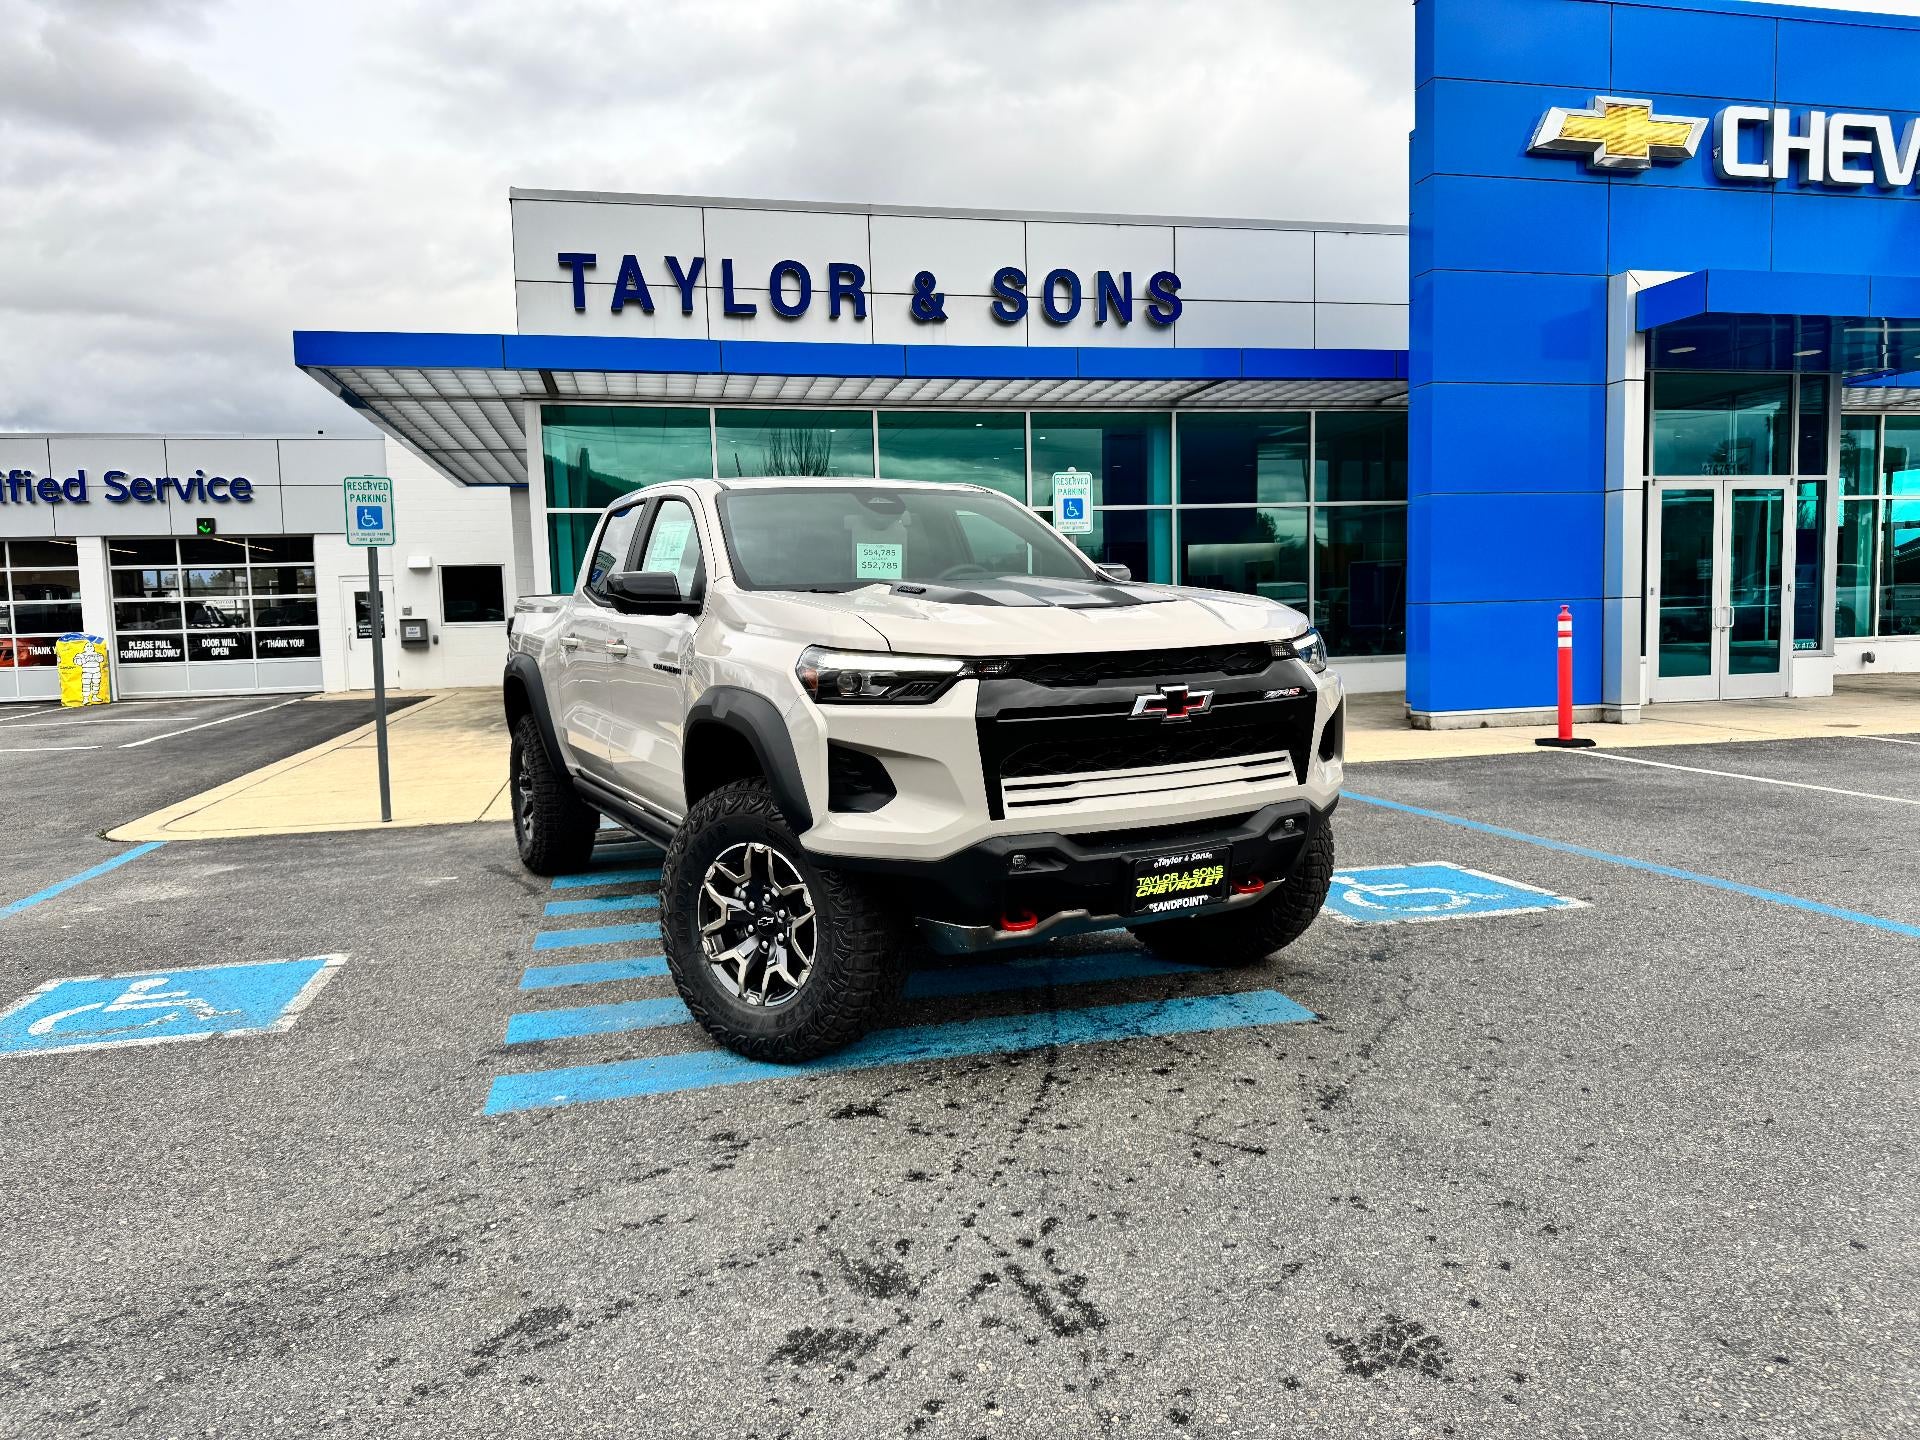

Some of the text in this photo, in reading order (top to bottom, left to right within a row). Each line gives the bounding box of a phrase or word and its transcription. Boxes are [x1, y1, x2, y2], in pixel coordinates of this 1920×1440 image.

[557, 252, 1183, 326] TAYLOR & SONS
[103, 470, 253, 501] Service
[347, 481, 389, 491] RESERVED
[1056, 477, 1089, 486] RESERVED
[1058, 487, 1087, 496] PARKING
[350, 493, 387, 503] PARKING
[863, 549, 896, 557] $54,785
[861, 561, 898, 570] $52,785
[128, 640, 172, 650] PLEASE PULL
[202, 639, 238, 648] DOOR WILL
[267, 639, 305, 648] THANK YOU!
[28, 646, 52, 656] THANK
[120, 649, 181, 659] FORWARD SLOWLY
[211, 648, 229, 656] OPEN
[1158, 855, 1183, 867] Taylor
[1191, 852, 1210, 861] Sons
[1137, 865, 1224, 886] TAYLOR & SONS
[1136, 876, 1222, 897] CHEVROLET
[1152, 895, 1205, 913] SANDPOINT
